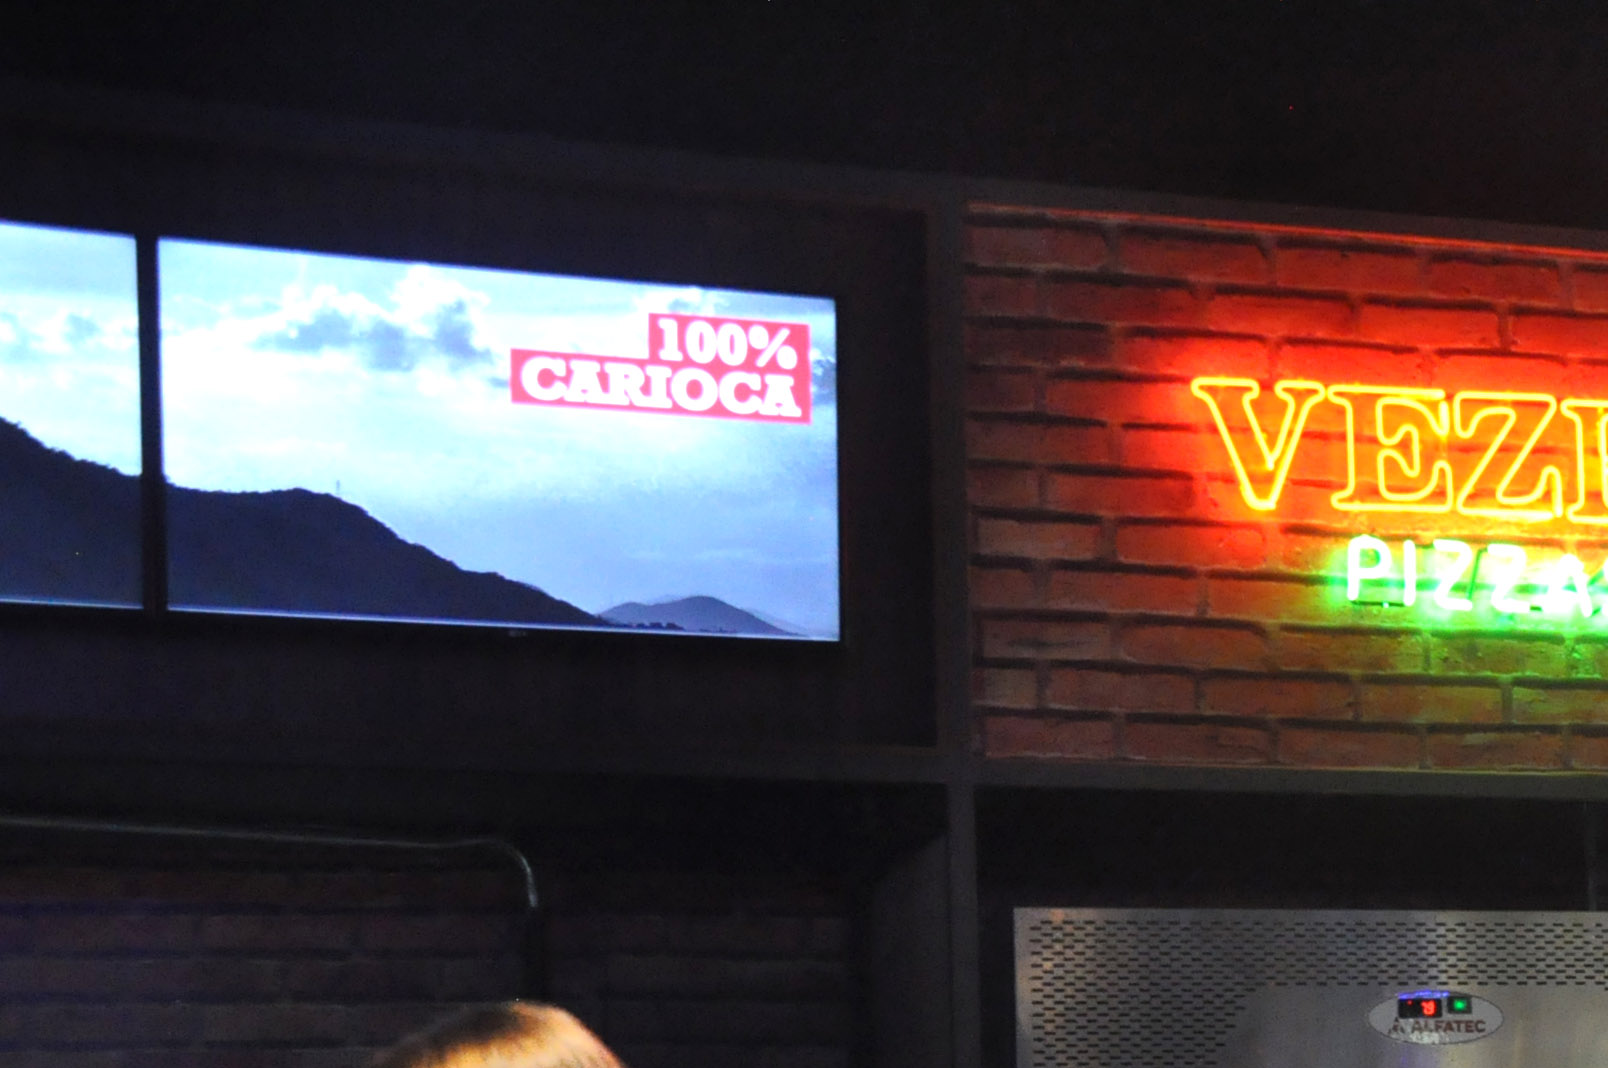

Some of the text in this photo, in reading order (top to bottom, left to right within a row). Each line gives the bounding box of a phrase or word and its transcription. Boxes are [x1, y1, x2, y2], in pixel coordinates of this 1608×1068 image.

[658, 318, 798, 370] 100%
[520, 356, 802, 417] CARIOCA
[1411, 1019, 1487, 1033] ALFATEC
